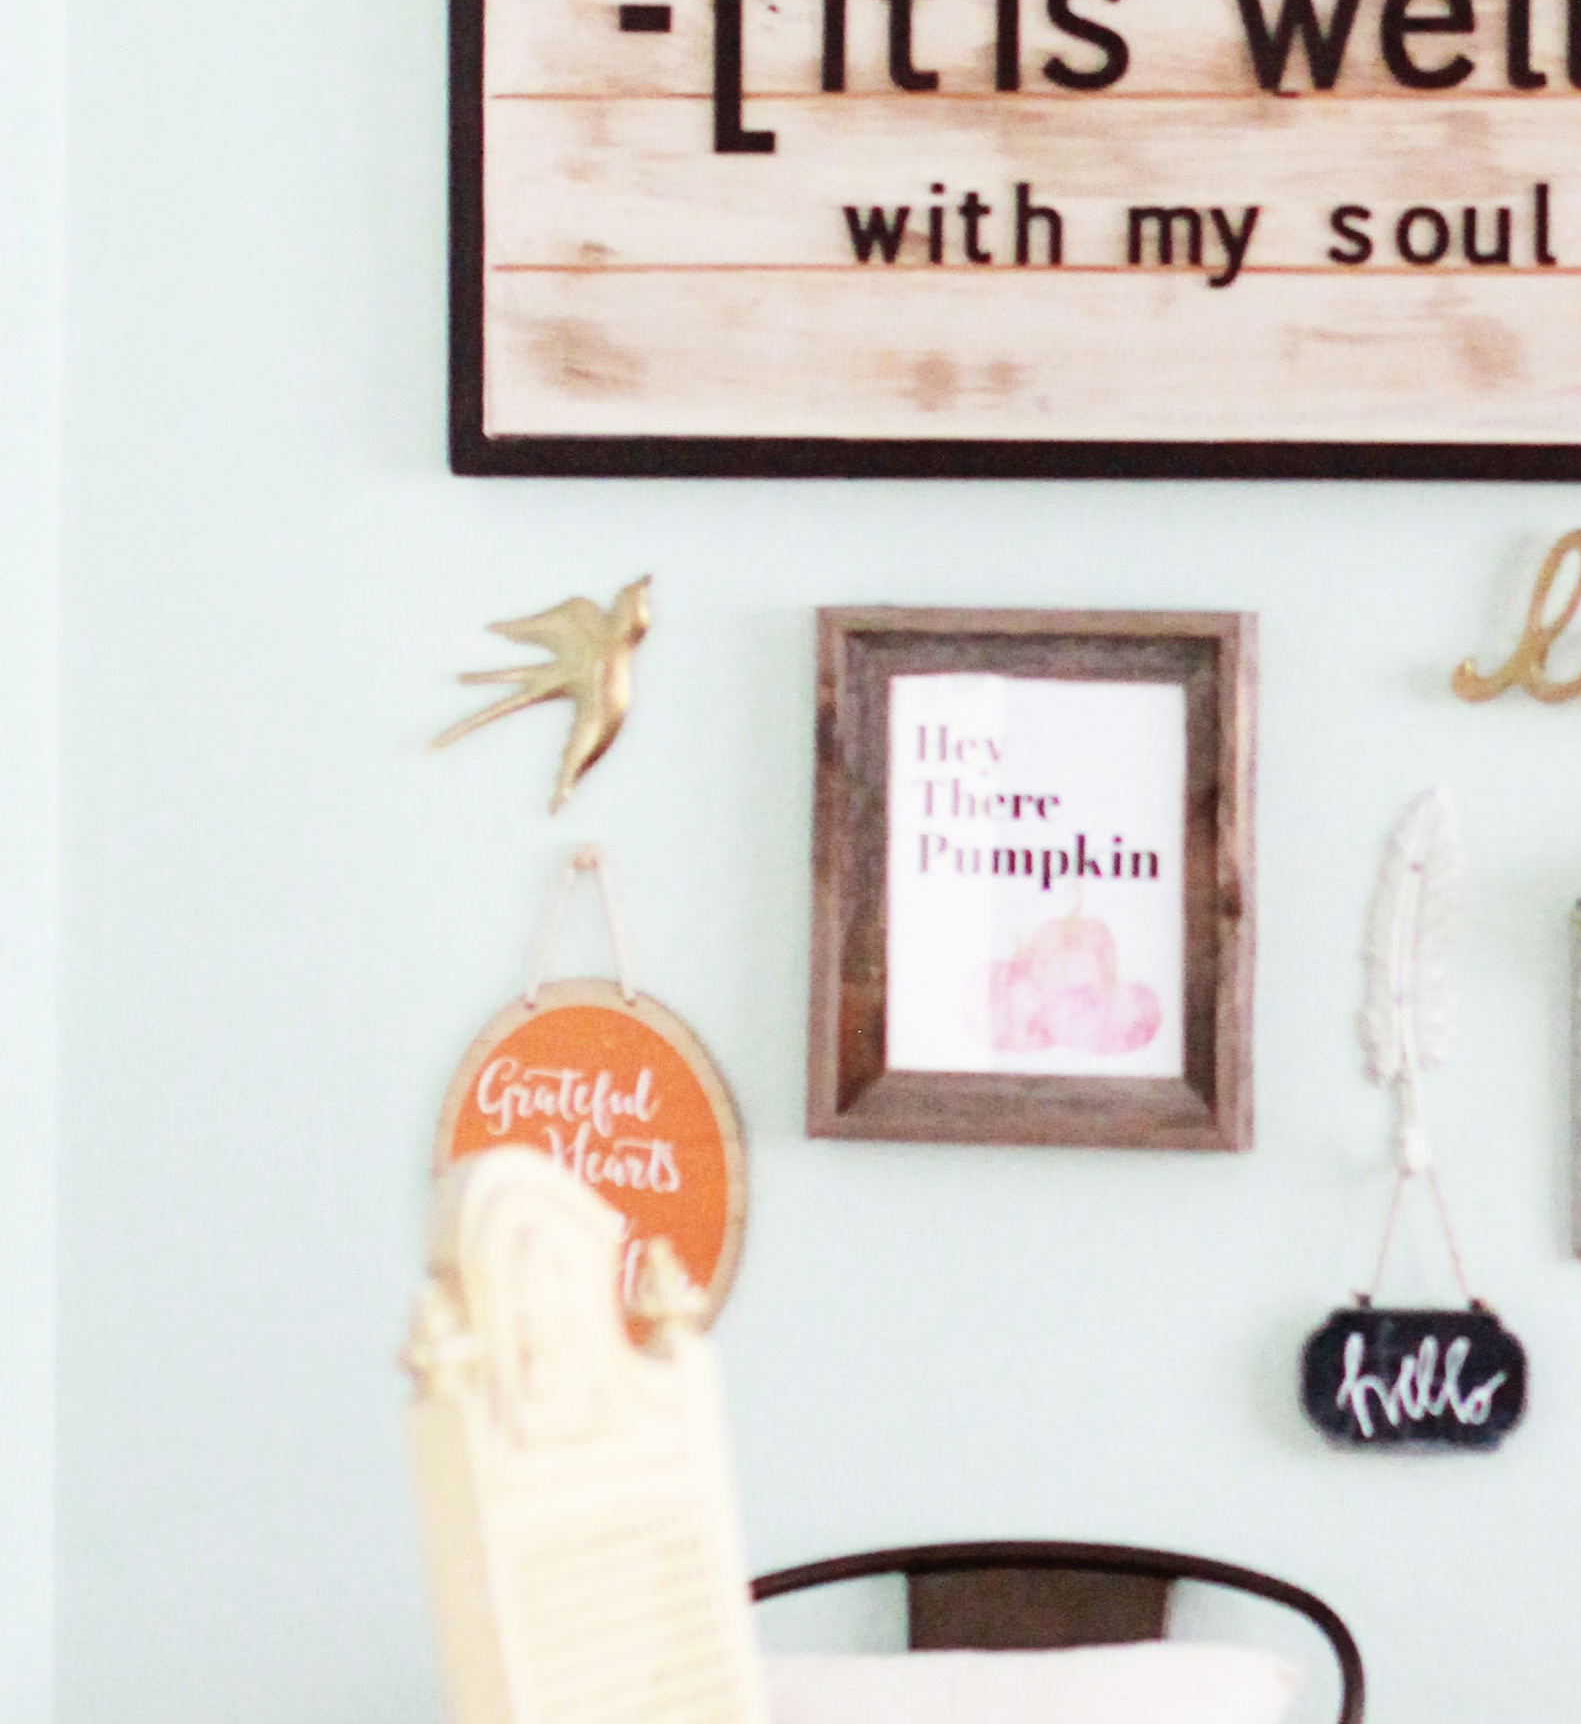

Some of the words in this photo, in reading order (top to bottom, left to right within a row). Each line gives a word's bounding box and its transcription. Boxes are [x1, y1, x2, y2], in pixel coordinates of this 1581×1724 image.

[845, 184, 1063, 264] with
[1126, 206, 1260, 287] my
[1329, 184, 1558, 264] soul
[917, 724, 1006, 776] Hey
[914, 778, 1061, 819] There
[917, 833, 1160, 891] Pumpkin
[477, 1058, 664, 1137] Grateful
[1336, 1332, 1507, 1438] hello
